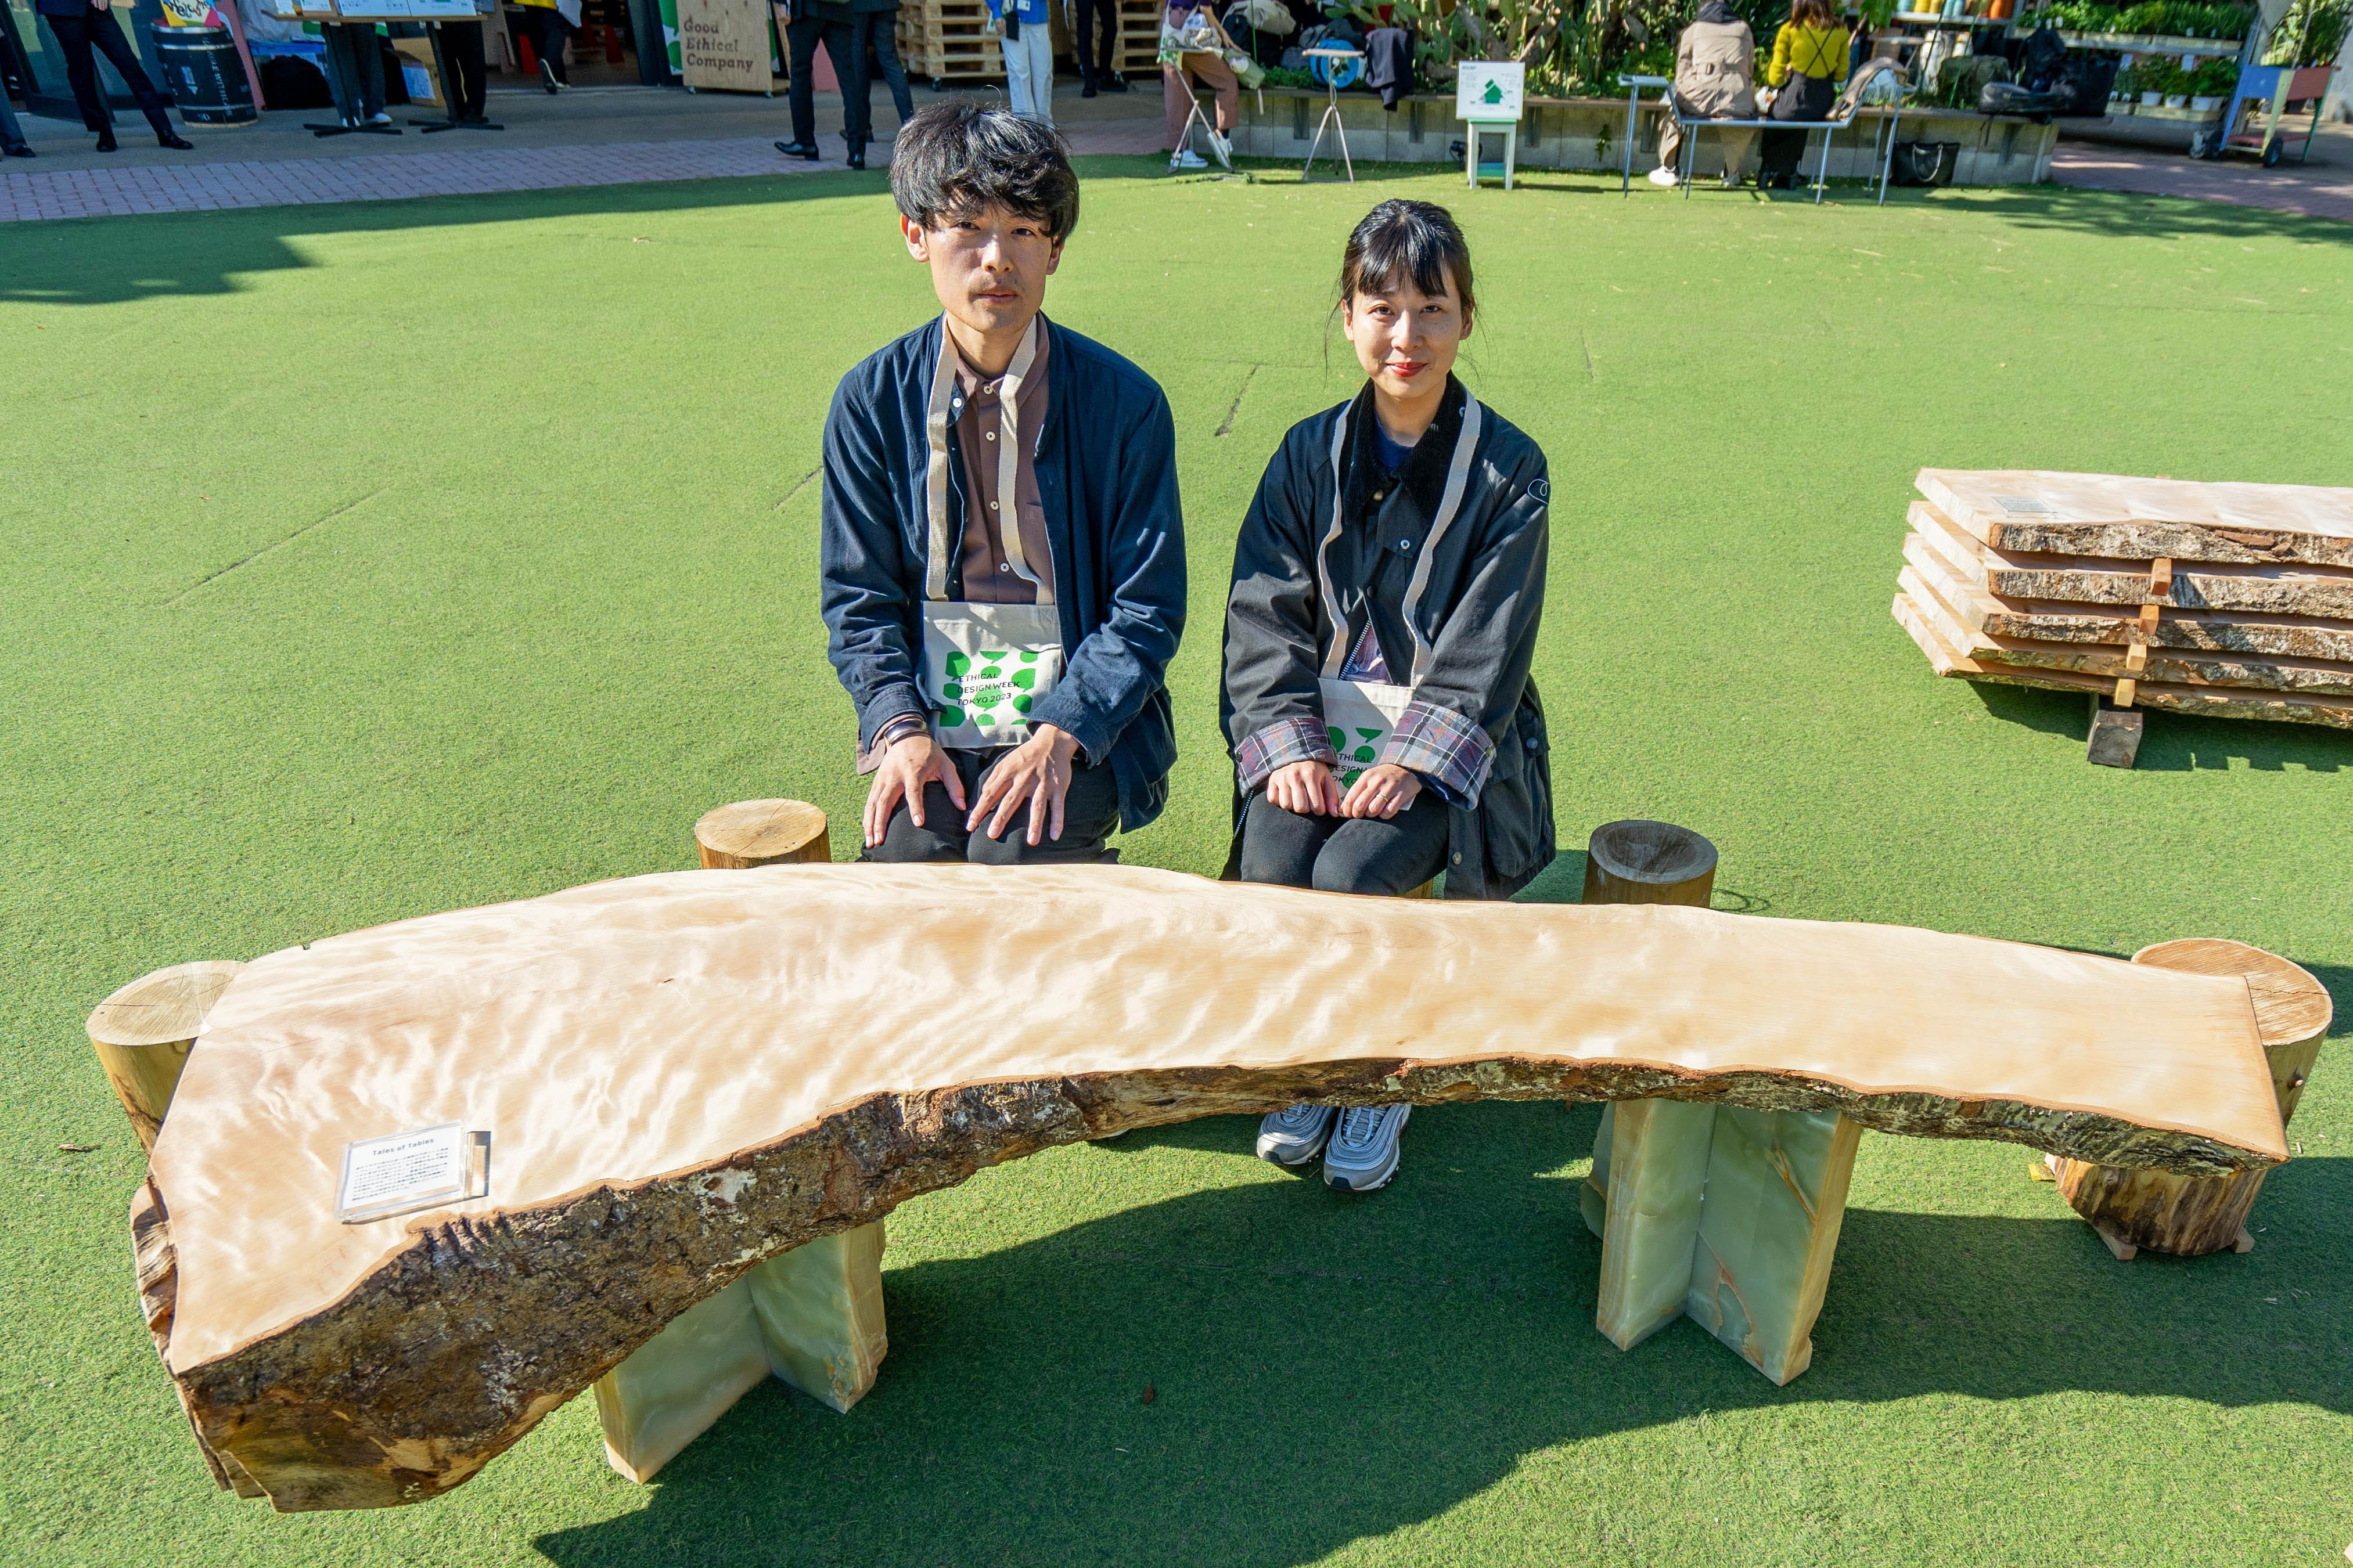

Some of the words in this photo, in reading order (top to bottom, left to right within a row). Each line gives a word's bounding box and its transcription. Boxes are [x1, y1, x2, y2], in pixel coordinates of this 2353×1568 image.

[684, 19, 719, 34] Good
[686, 37, 739, 52] Ethical
[686, 53, 754, 73] Company
[959, 673, 998, 682] ETHICAL
[958, 684, 991, 693] DESIGN
[957, 697, 988, 705] TOKYO
[990, 693, 1012, 702] 2023
[1339, 753, 1372, 763] THICAL
[409, 1138, 435, 1148] Tables
